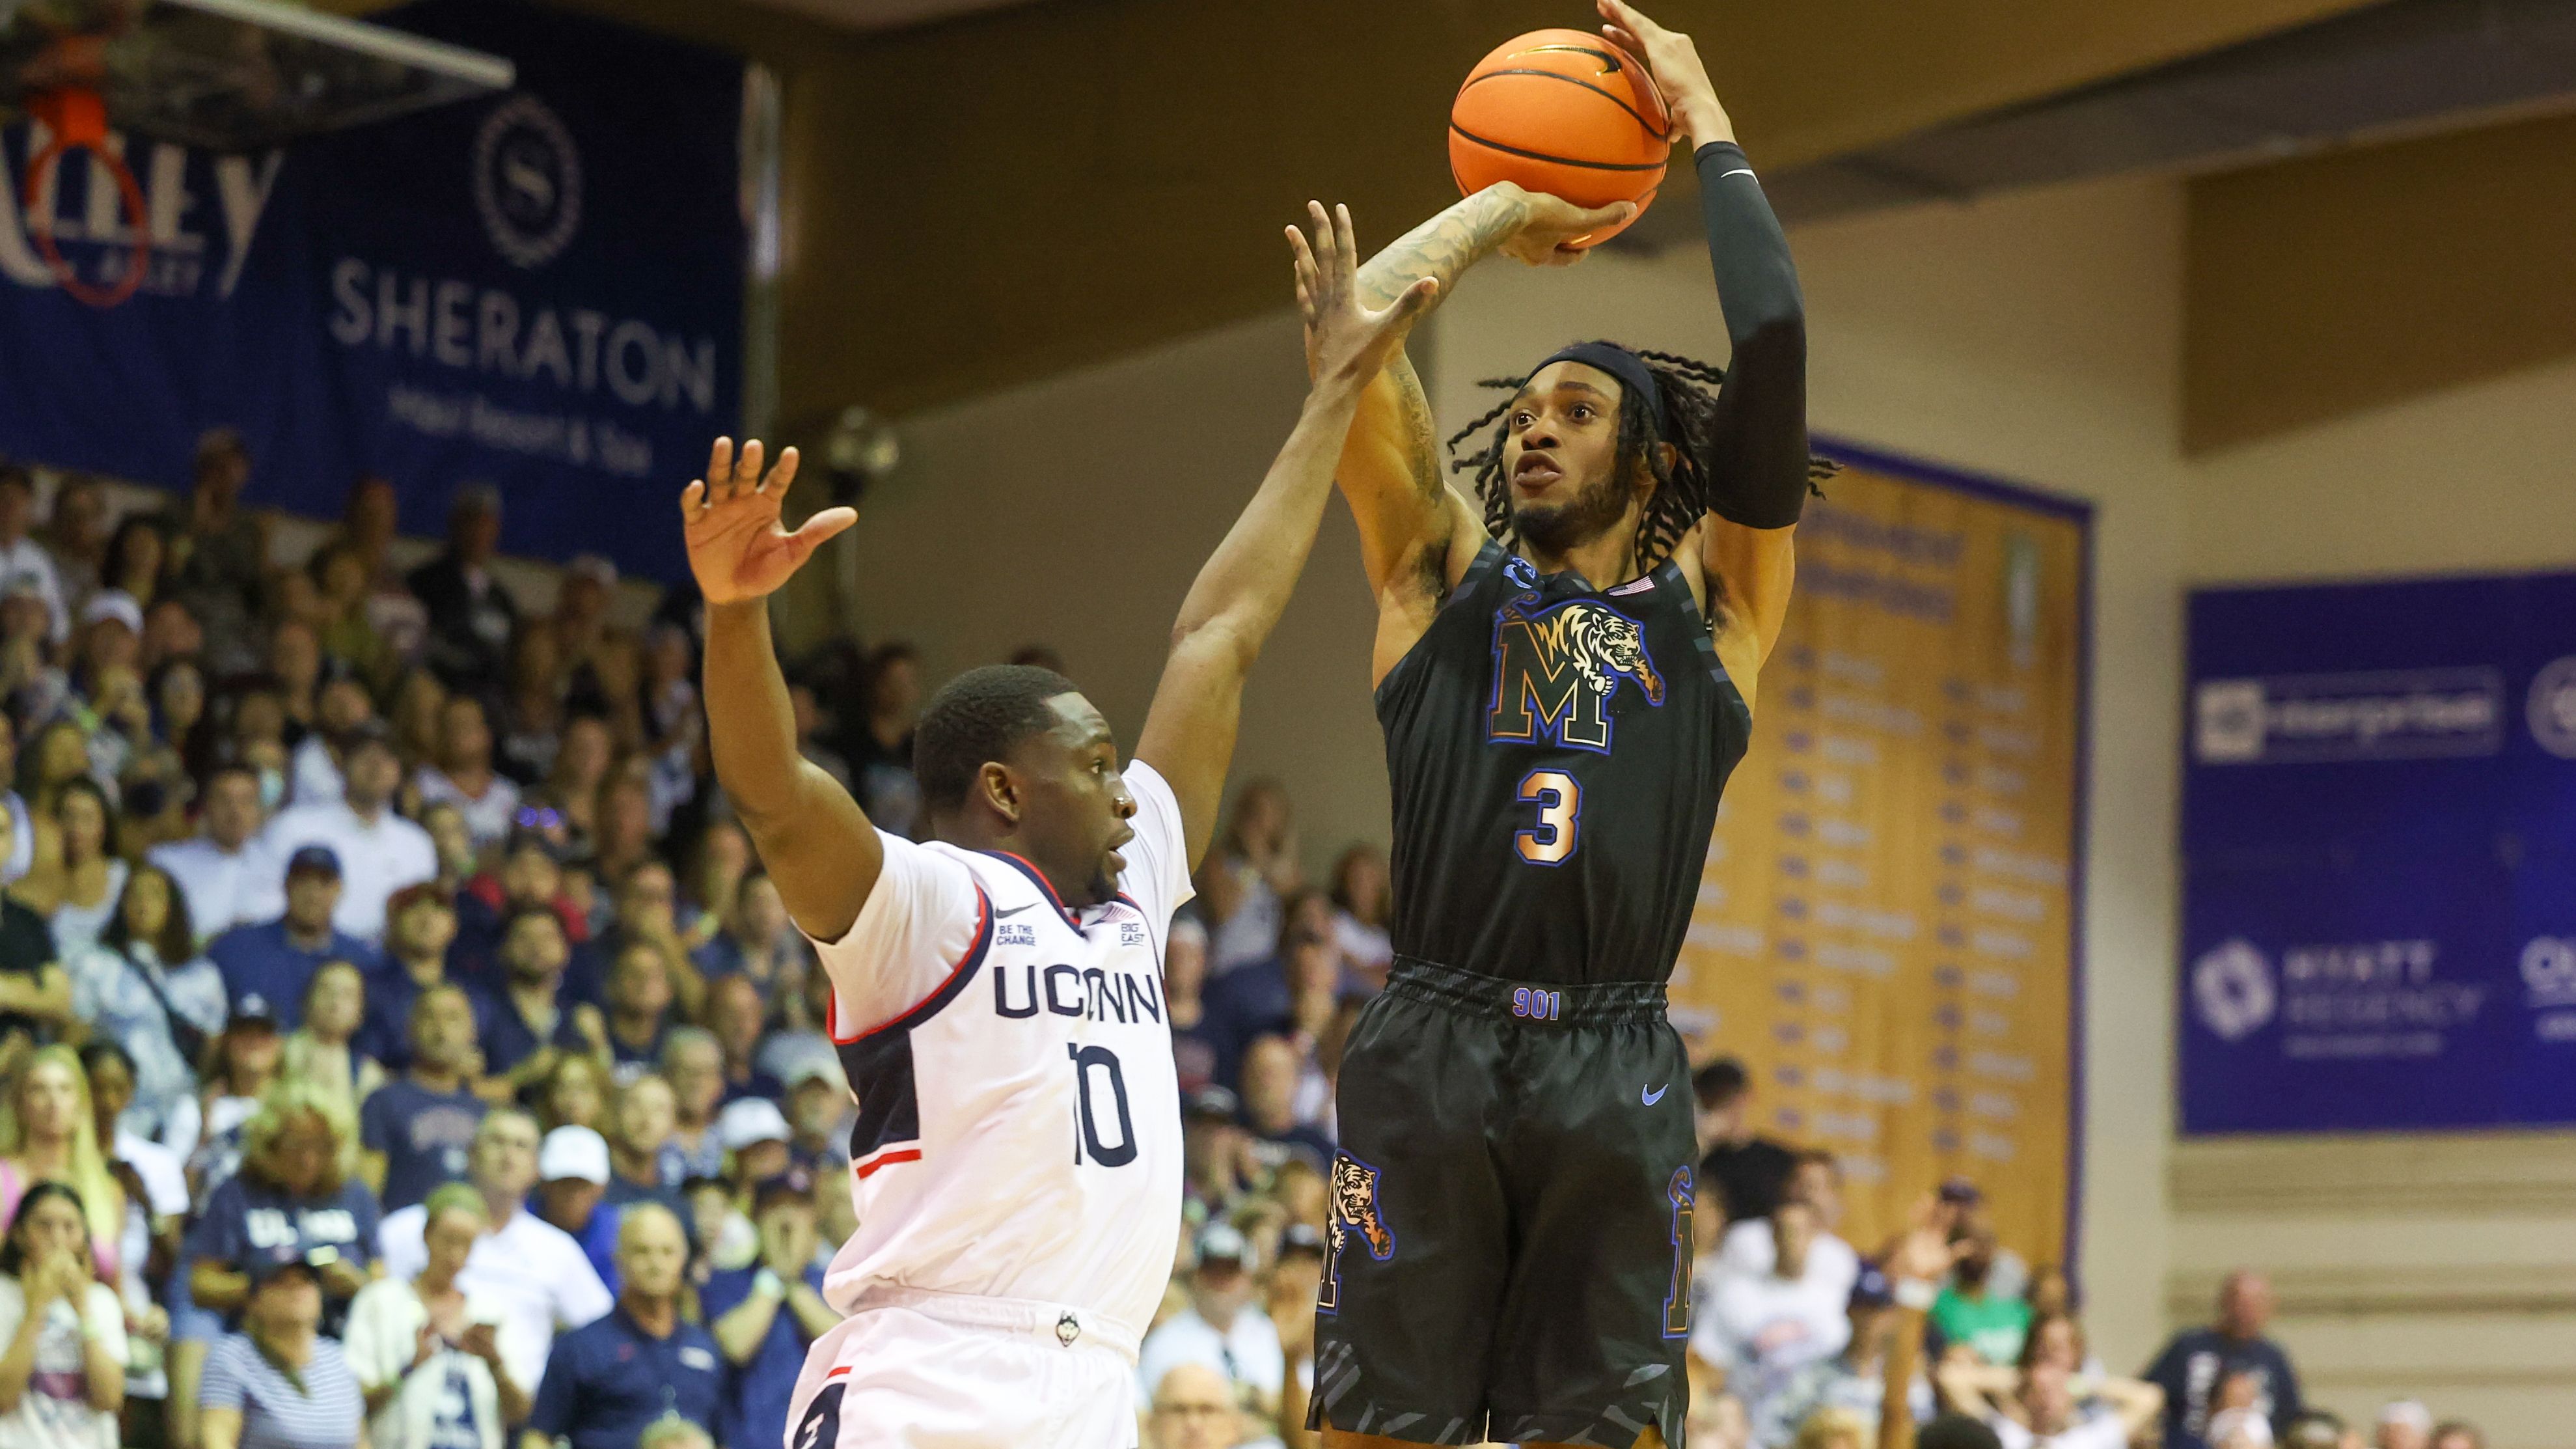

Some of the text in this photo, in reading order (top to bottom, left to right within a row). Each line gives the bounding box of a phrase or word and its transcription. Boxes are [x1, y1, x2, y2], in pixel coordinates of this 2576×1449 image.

[329, 256, 716, 412] SHERATON
[1487, 618, 1613, 755] M
[1514, 767, 1582, 866] 3
[996, 935, 1035, 946] CHANGE
[1000, 925, 1034, 935] BE THE
[1121, 923, 1140, 932] BIG
[1121, 933, 1145, 943] EAST
[994, 963, 1160, 1024] UCONN
[1513, 987, 1560, 1021] 901
[1067, 1042, 1138, 1168] 10
